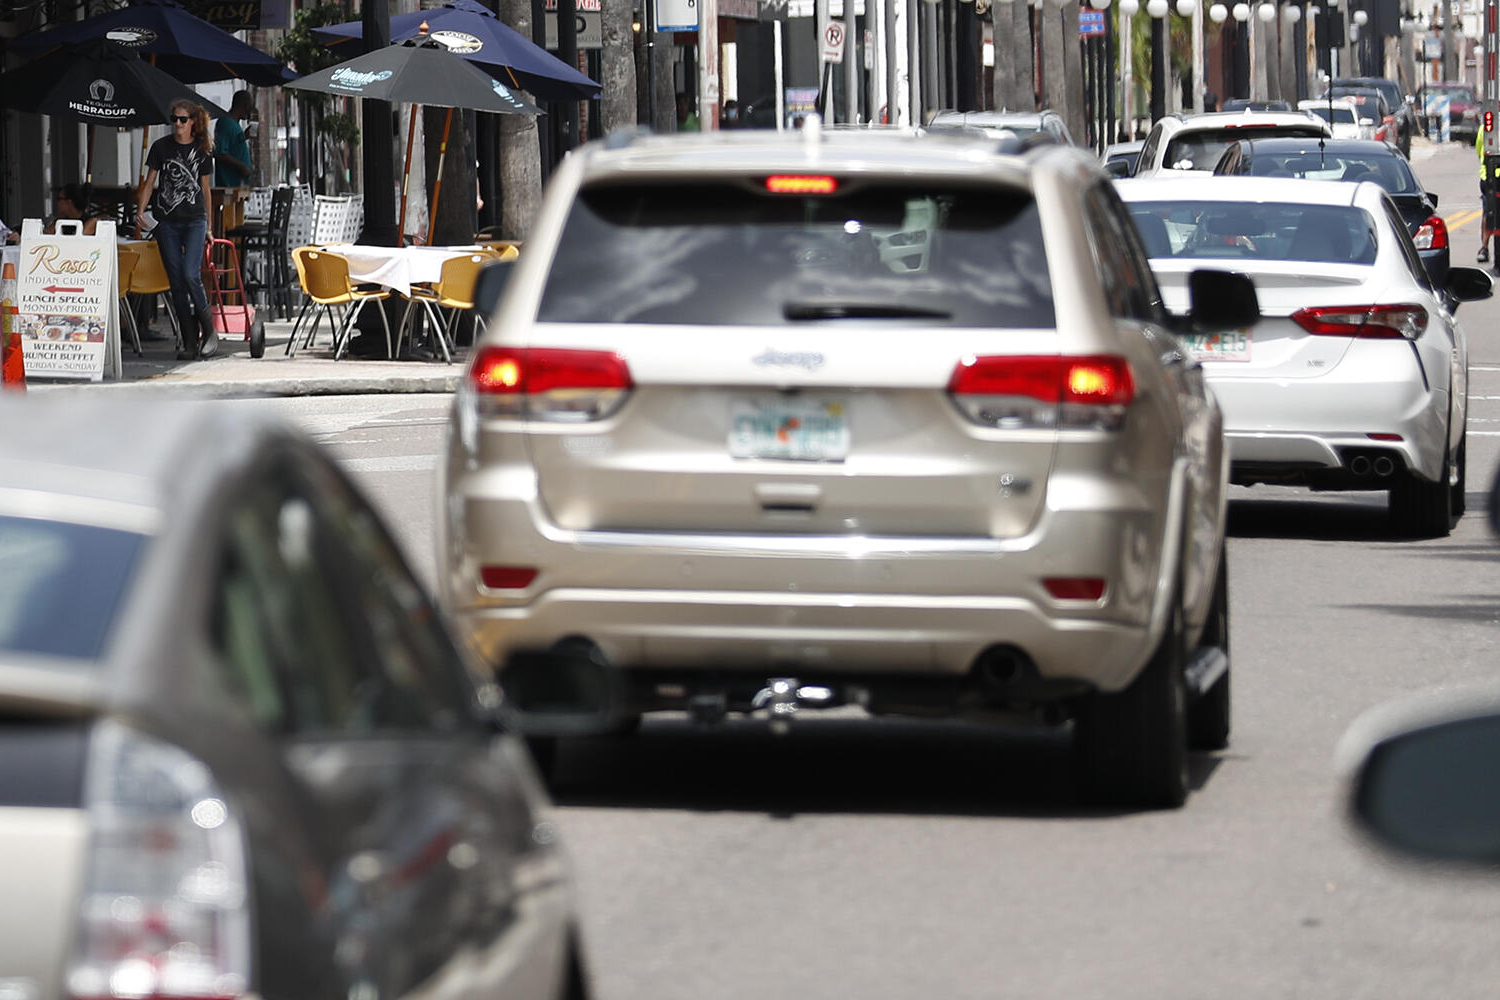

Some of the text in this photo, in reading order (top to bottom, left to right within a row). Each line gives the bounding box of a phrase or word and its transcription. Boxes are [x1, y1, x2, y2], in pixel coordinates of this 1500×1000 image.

[69, 101, 136, 116] HERRADURA
[86, 100, 118, 108] TEQUILA
[29, 244, 99, 275] Rasoi
[24, 276, 102, 286] INDIAN CUISINE
[22, 295, 101, 305] LUNCH SPECIAL
[23, 304, 99, 313] MONDAY-FRIDAY
[33, 343, 82, 351] WEEKEND
[23, 352, 95, 361] RUNCH BUFFET
[63, 362, 98, 371] SUNDAY
